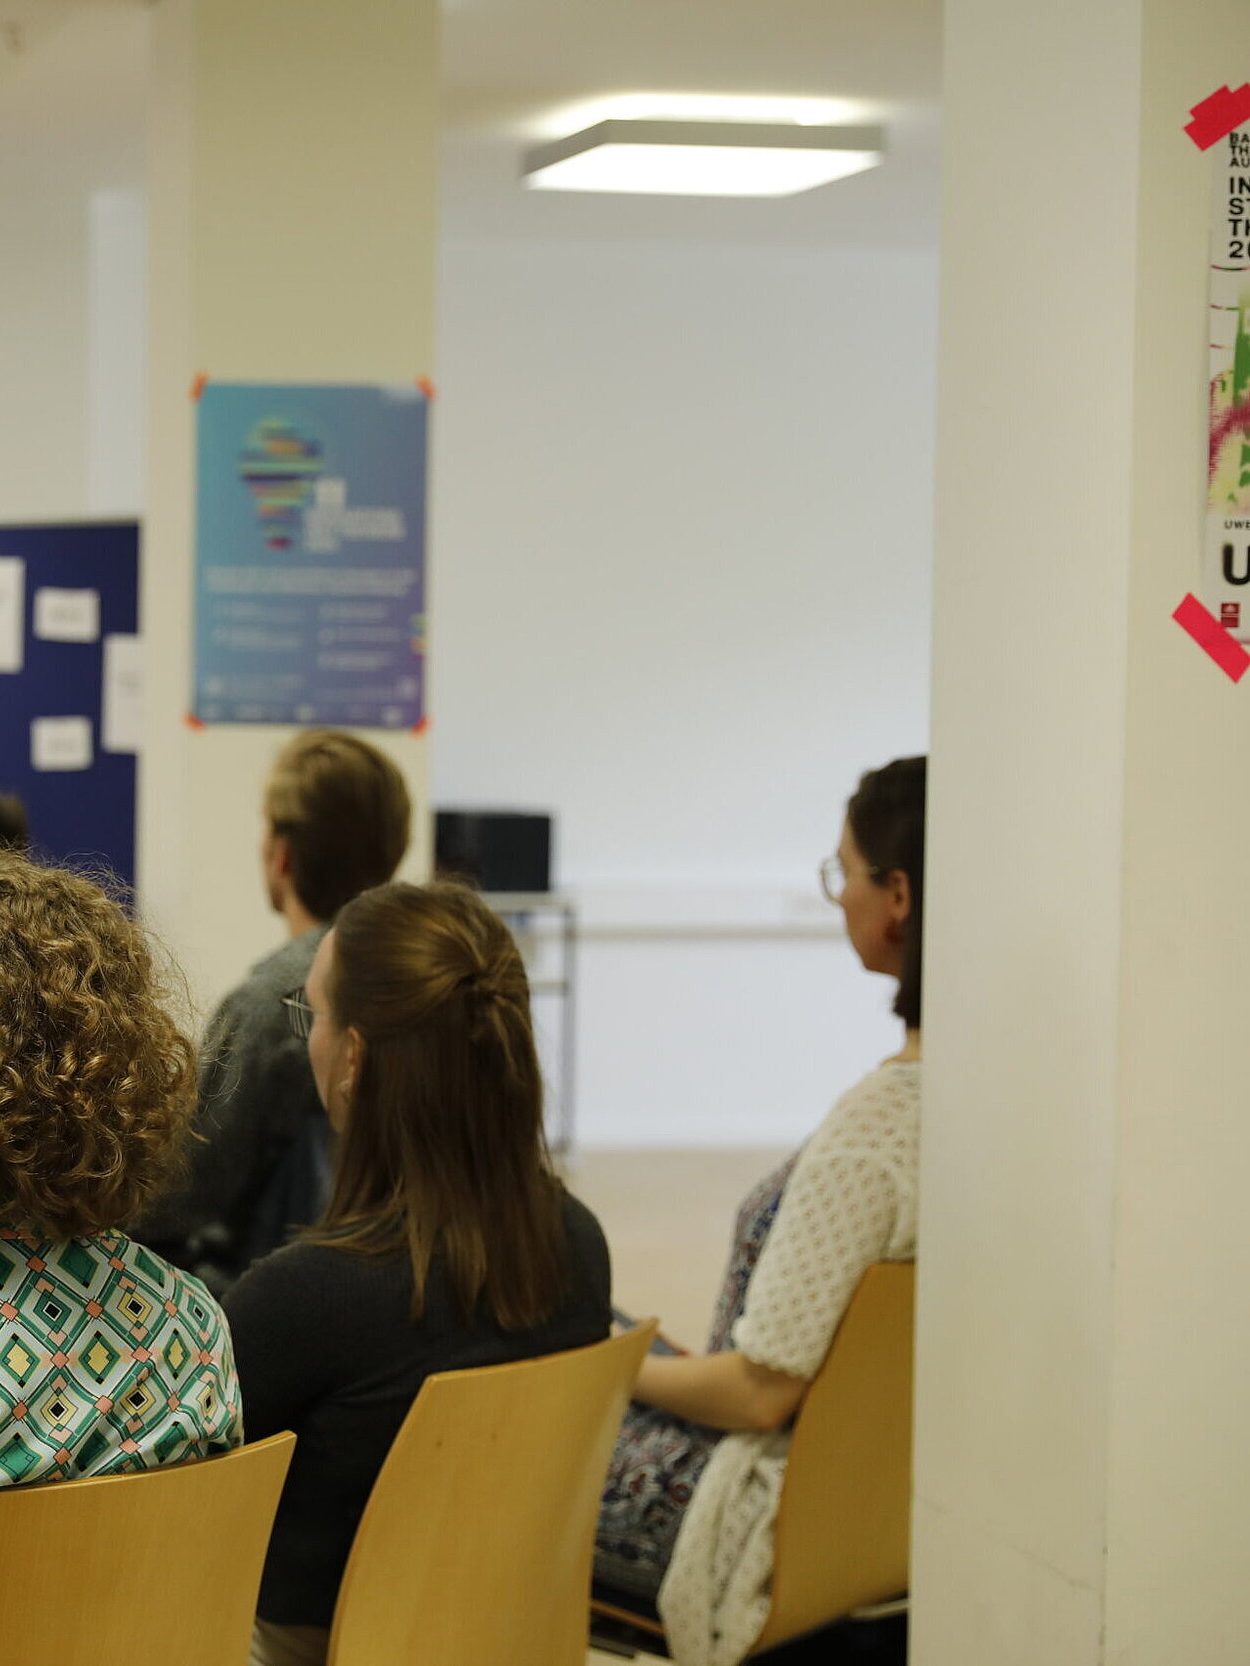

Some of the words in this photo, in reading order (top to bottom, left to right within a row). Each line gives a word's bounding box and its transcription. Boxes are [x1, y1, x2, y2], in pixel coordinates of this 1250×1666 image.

[1230, 157, 1250, 168] AU
[1229, 198, 1250, 214] S
[1230, 241, 1250, 258] 2
